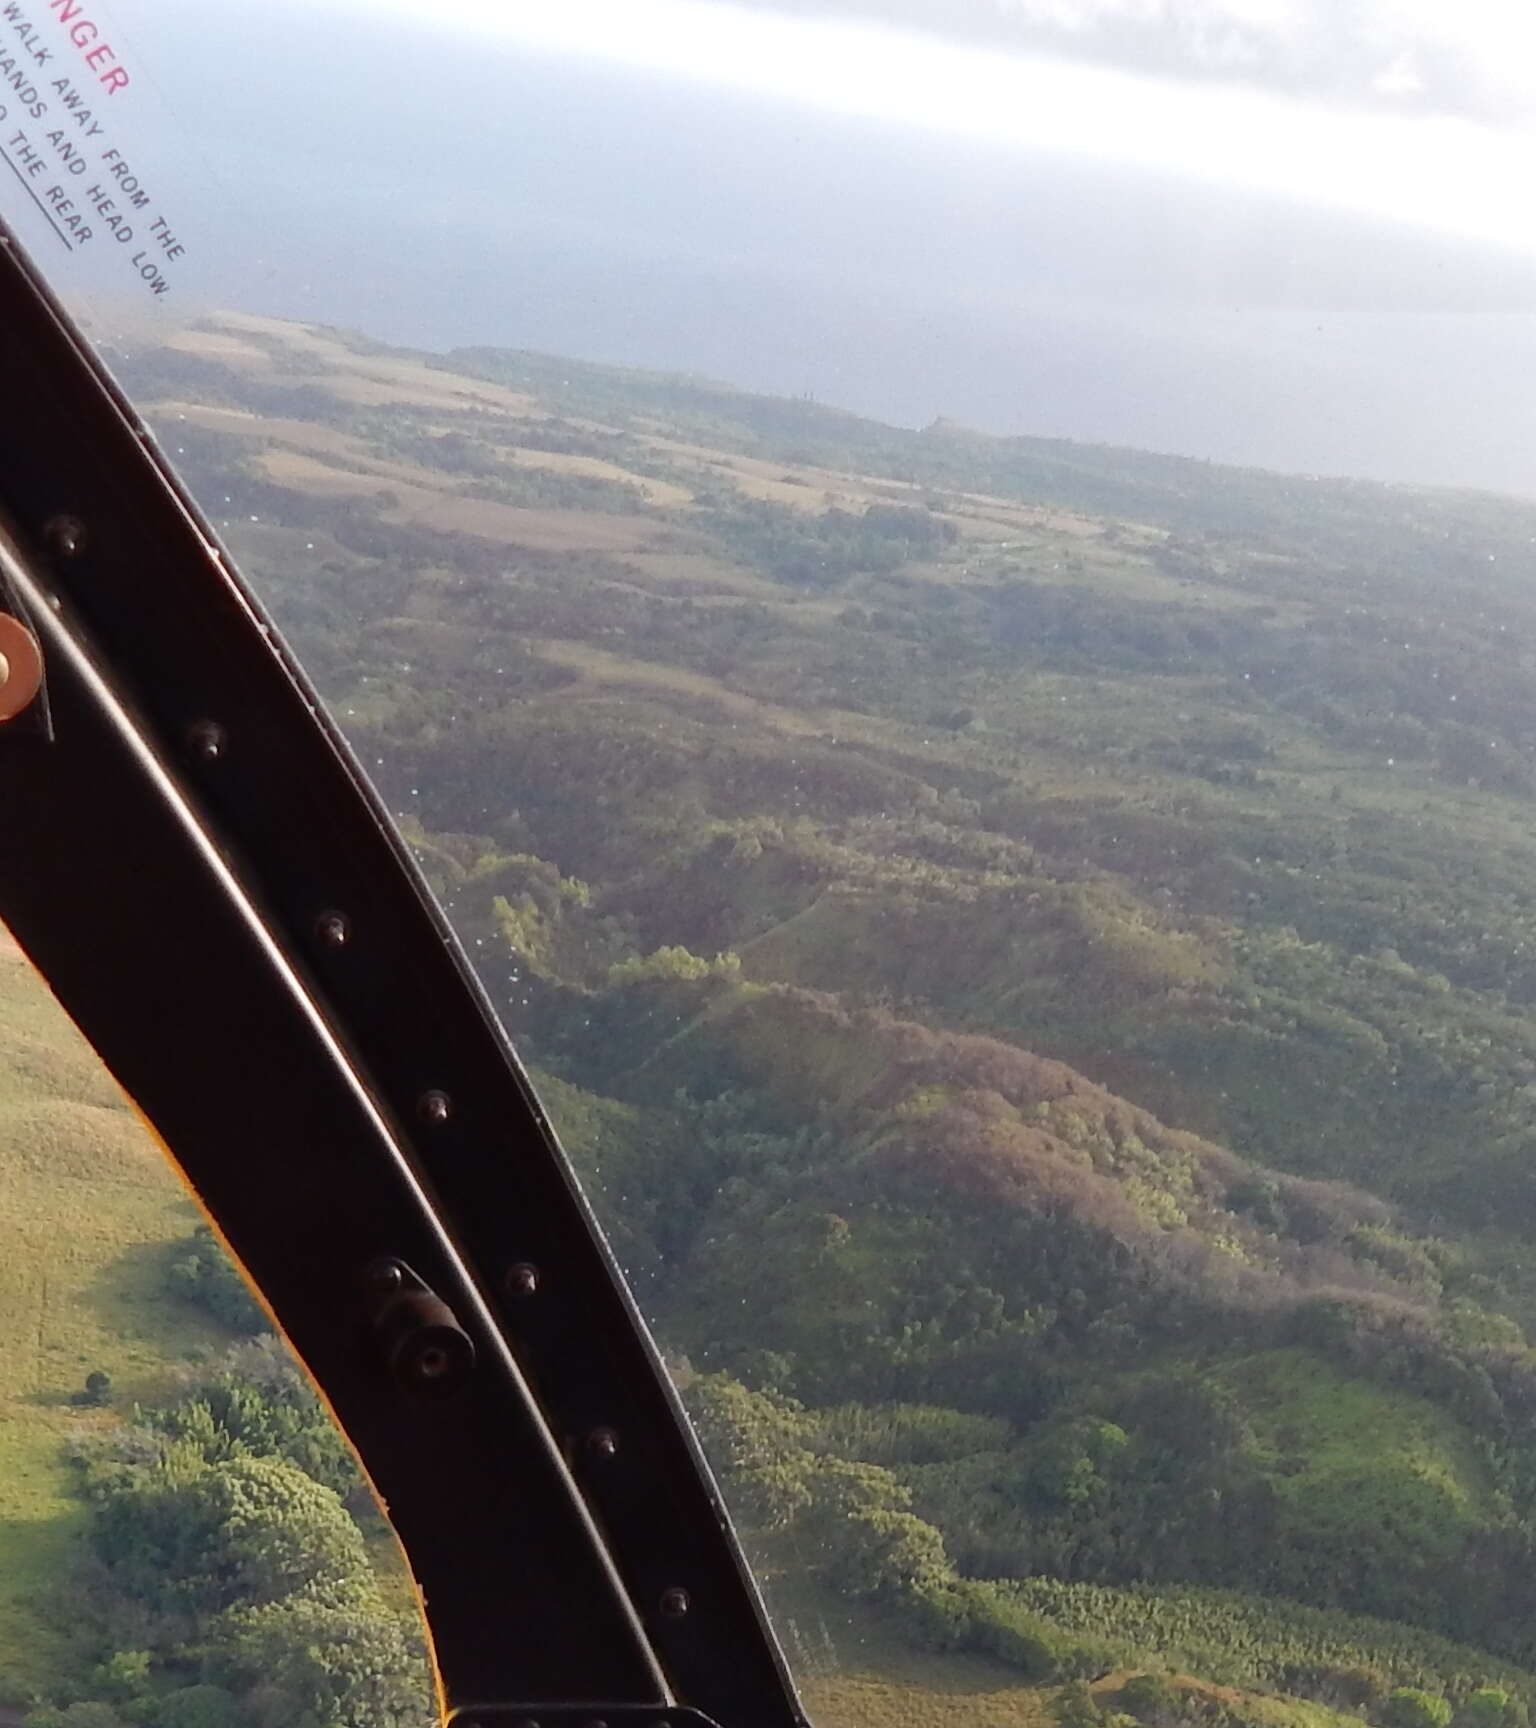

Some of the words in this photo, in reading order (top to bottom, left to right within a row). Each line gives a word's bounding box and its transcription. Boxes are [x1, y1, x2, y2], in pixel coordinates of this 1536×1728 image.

[3, 1, 54, 67] WALK
[51, 78, 104, 136] AWAY
[102, 148, 150, 210] FROM
[149, 216, 186, 262] THE
[9, 129, 48, 178] THE
[45, 185, 93, 244] REAR
[46, 130, 87, 175] AND
[86, 184, 134, 244] HEAD
